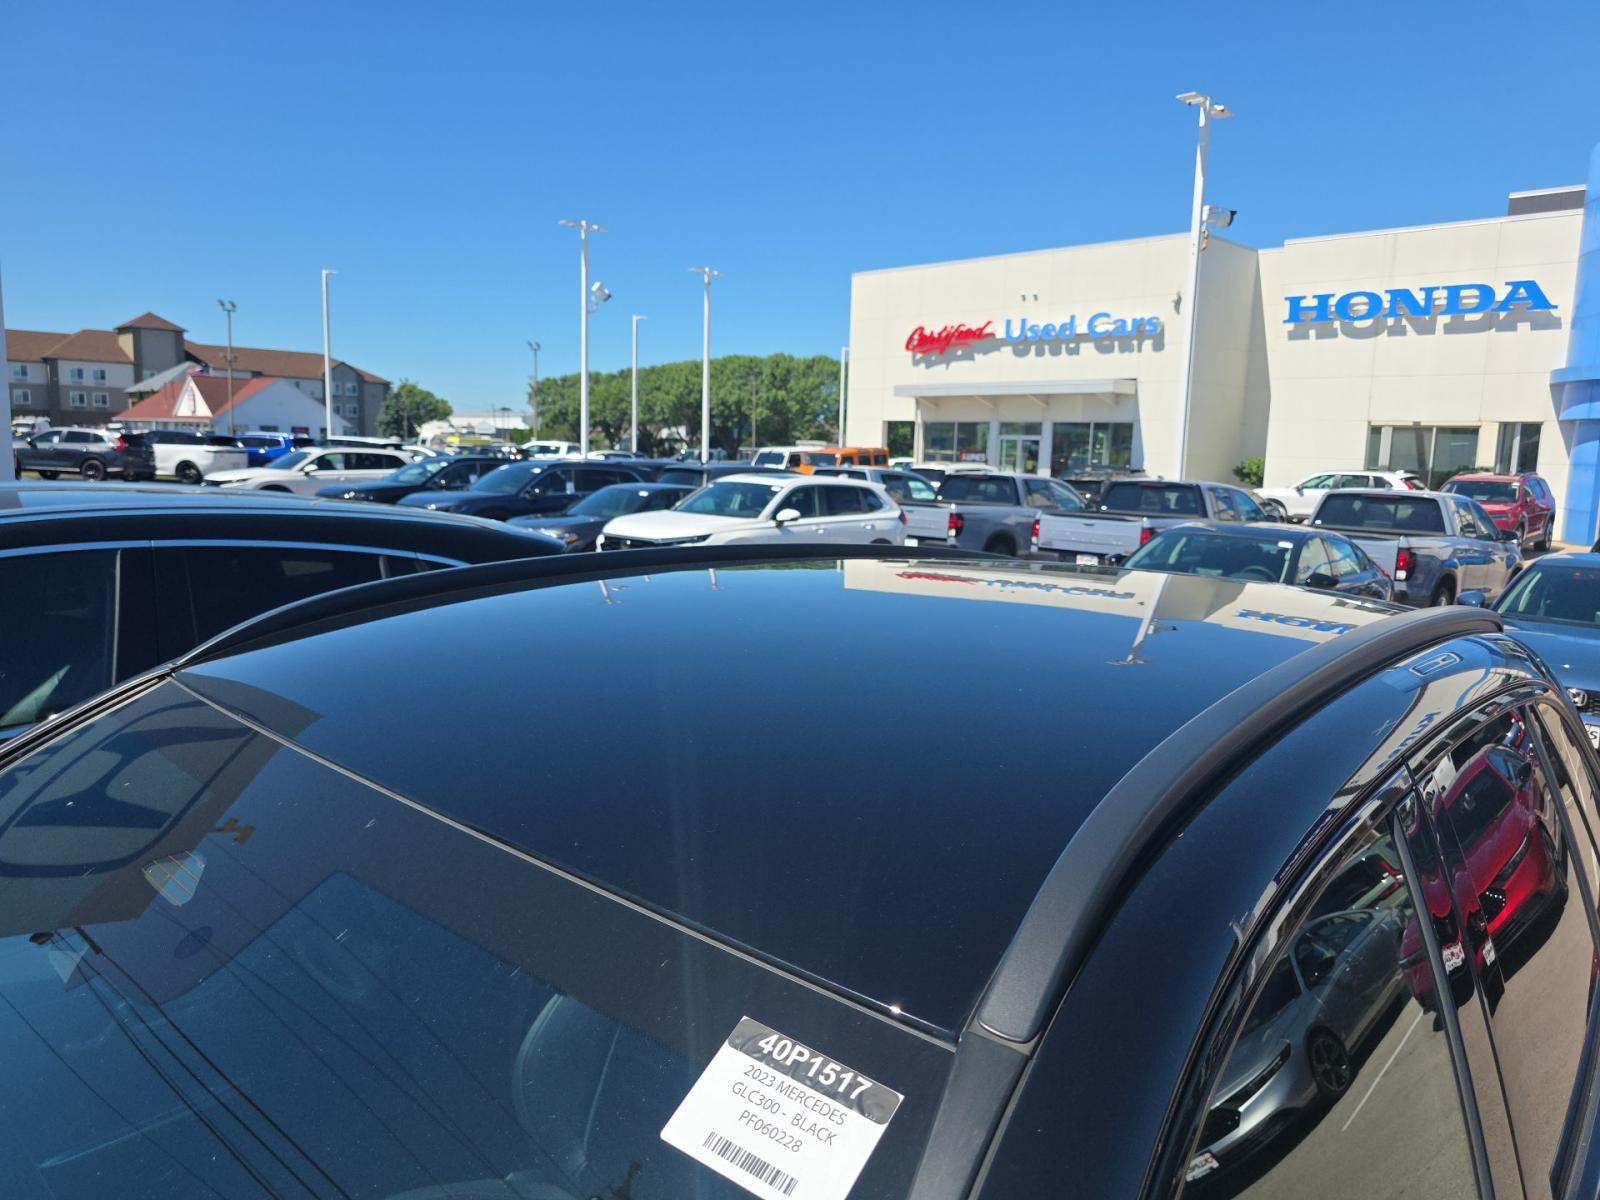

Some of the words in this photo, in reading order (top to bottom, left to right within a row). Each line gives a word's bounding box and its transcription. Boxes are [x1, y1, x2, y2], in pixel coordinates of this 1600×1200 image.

[1283, 280, 1558, 324] HONDA
[905, 321, 996, 354] Certified
[1005, 315, 1076, 343] Used
[1087, 312, 1161, 337] Cars
[758, 1034, 873, 1099] 40P1517
[732, 1081, 781, 1115] GLC300
[791, 1113, 838, 1146] BLACK
[744, 1064, 776, 1088] 2023
[775, 1080, 848, 1126] MERCEDES
[738, 1109, 803, 1153] PF060228
